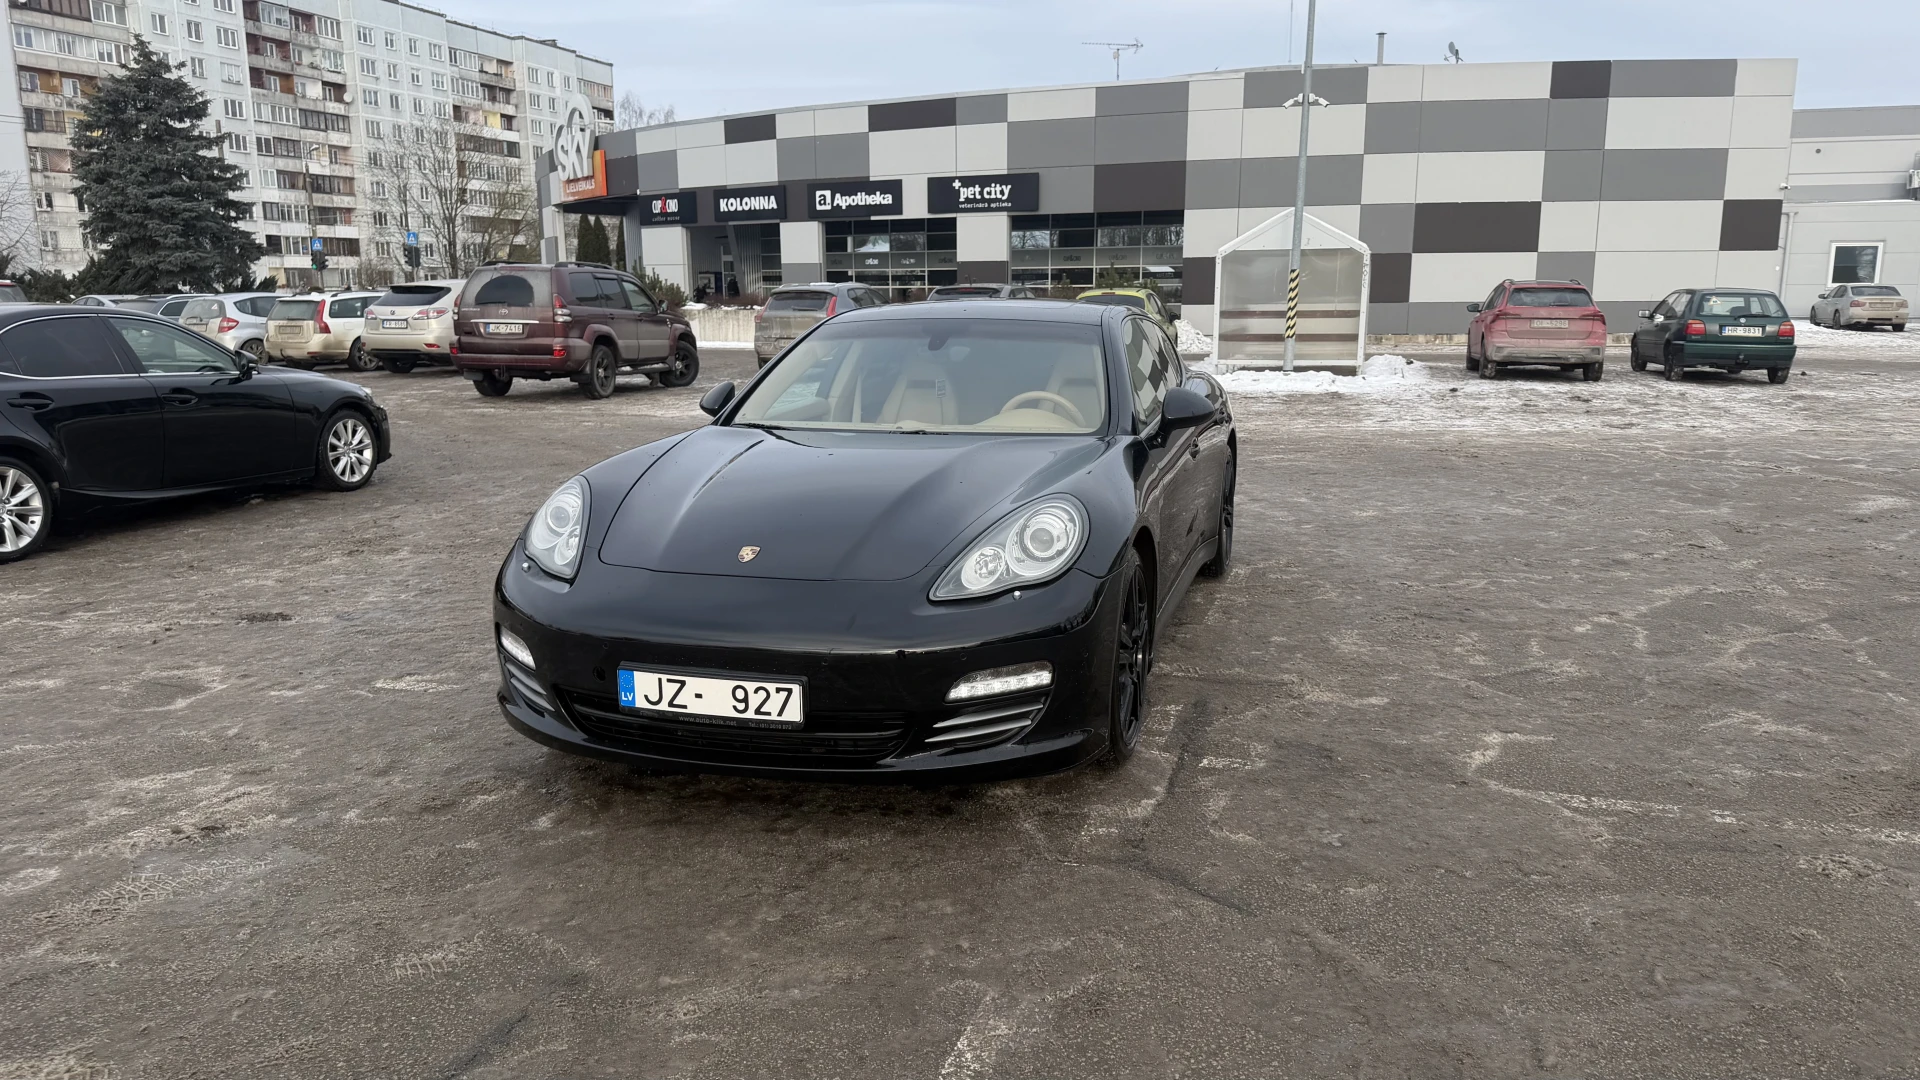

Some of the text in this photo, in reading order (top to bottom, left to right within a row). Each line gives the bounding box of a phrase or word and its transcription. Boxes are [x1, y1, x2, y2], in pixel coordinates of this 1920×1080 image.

[556, 126, 592, 181] SKY
[566, 178, 595, 193] LIELVEIKALS
[959, 183, 1011, 201] pet city
[652, 197, 679, 213] CUP&CINO
[720, 195, 778, 212] KOLONNA
[833, 191, 892, 209] Apotheka
[990, 201, 1012, 209] aptieka
[491, 323, 522, 332] JK-7416
[621, 692, 634, 701] LV
[731, 684, 794, 717] 927
